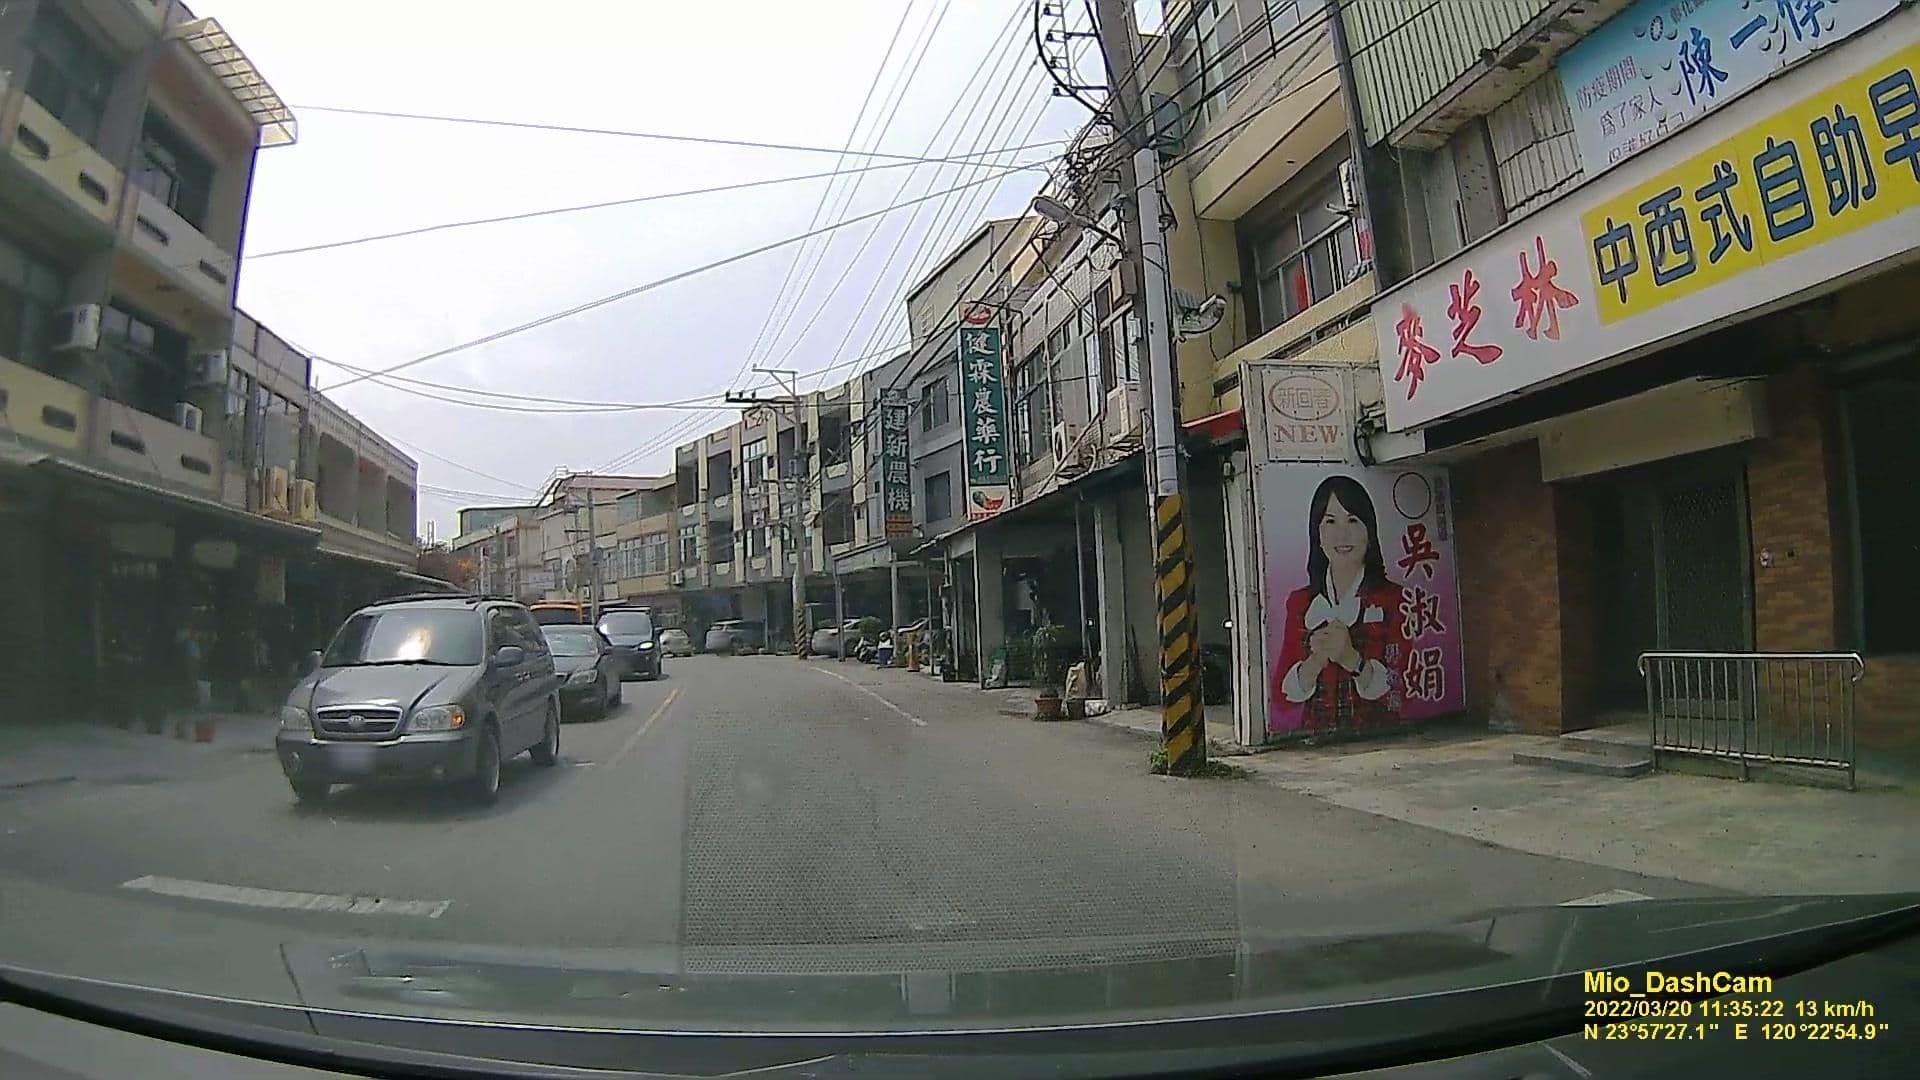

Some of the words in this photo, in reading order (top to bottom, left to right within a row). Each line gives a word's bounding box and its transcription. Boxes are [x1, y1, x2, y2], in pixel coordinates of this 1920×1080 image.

[1576, 55, 1637, 112] 防疫期間
[1592, 68, 1920, 306] 中西式自助早
[884, 407, 911, 513] 建新農機
[1273, 424, 1339, 443] NEW
[1397, 522, 1447, 701] 吳淑娟
